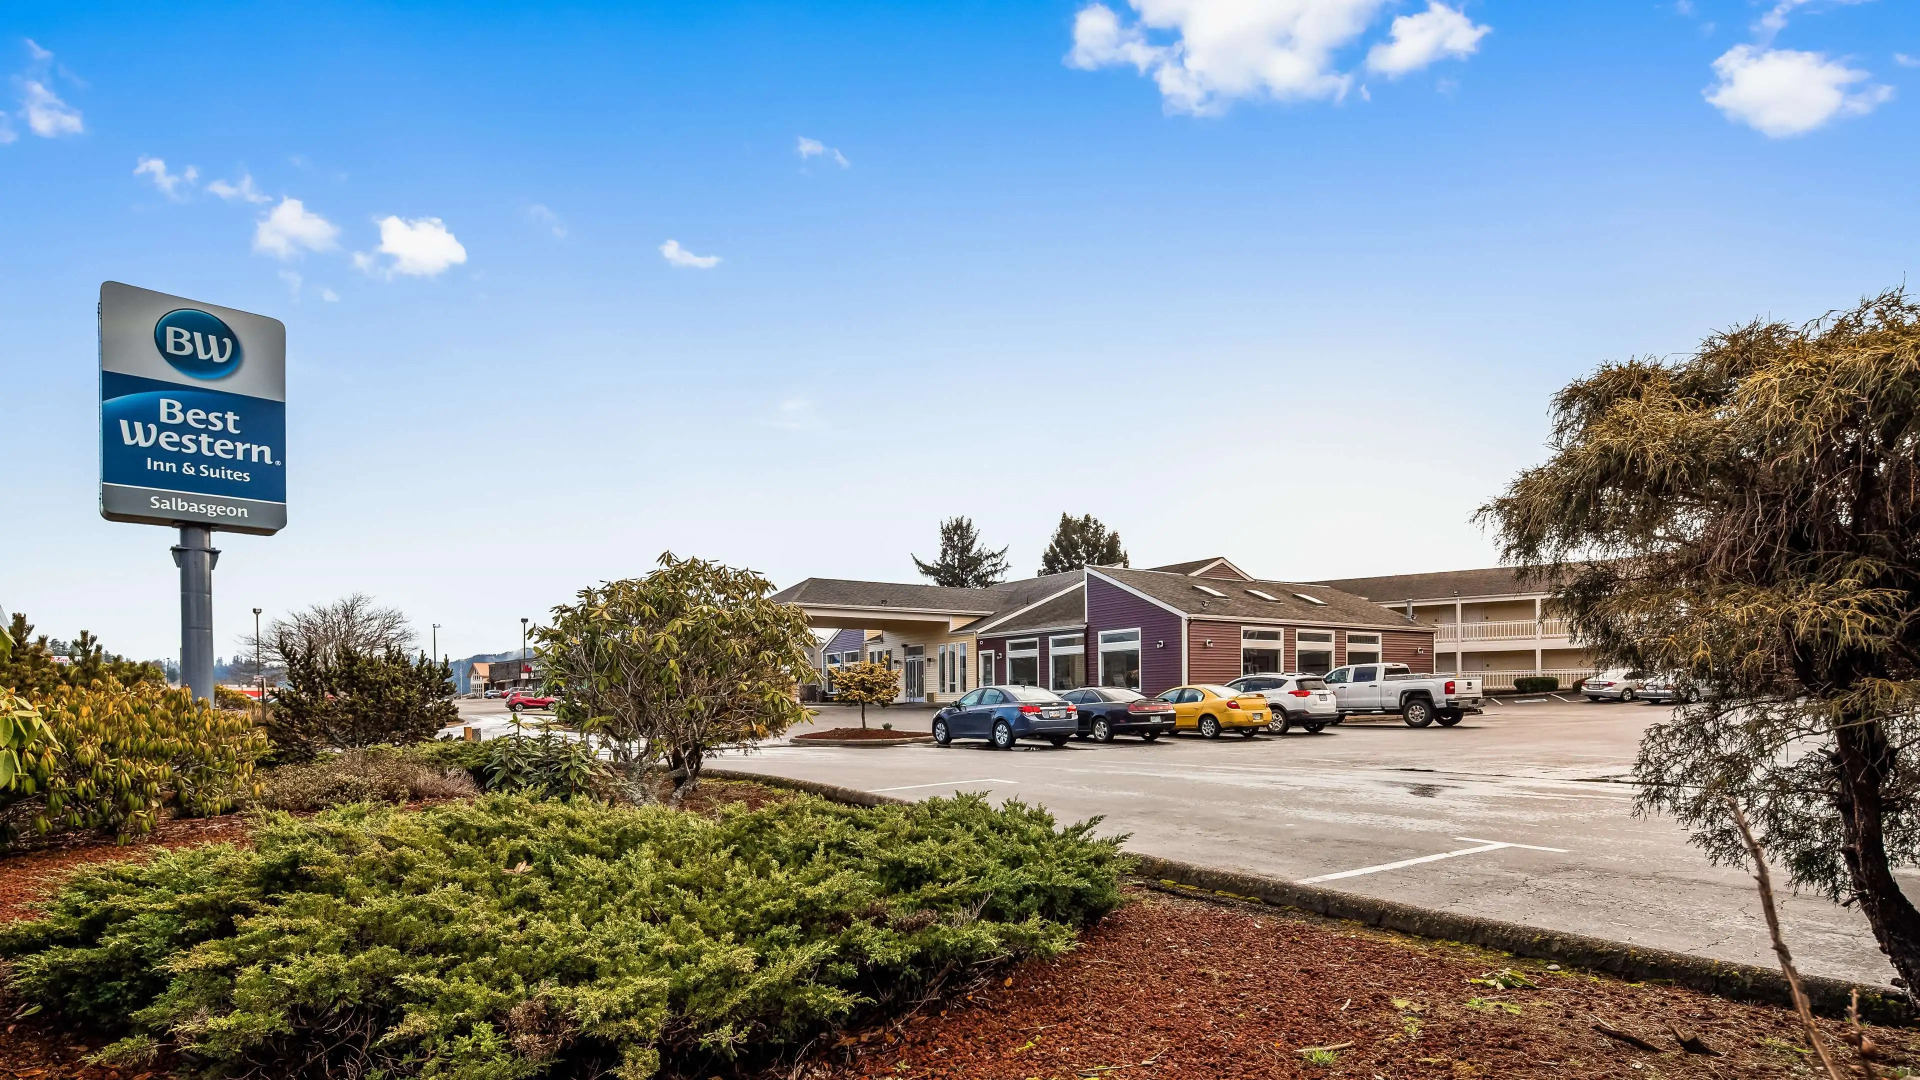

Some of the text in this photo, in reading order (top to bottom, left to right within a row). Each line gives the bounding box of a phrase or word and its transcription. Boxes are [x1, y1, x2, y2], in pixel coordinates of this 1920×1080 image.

[166, 326, 233, 363] BW
[159, 398, 241, 434] Best
[147, 457, 251, 482] Inn & Suites
[150, 496, 249, 518] Salbasgeon
